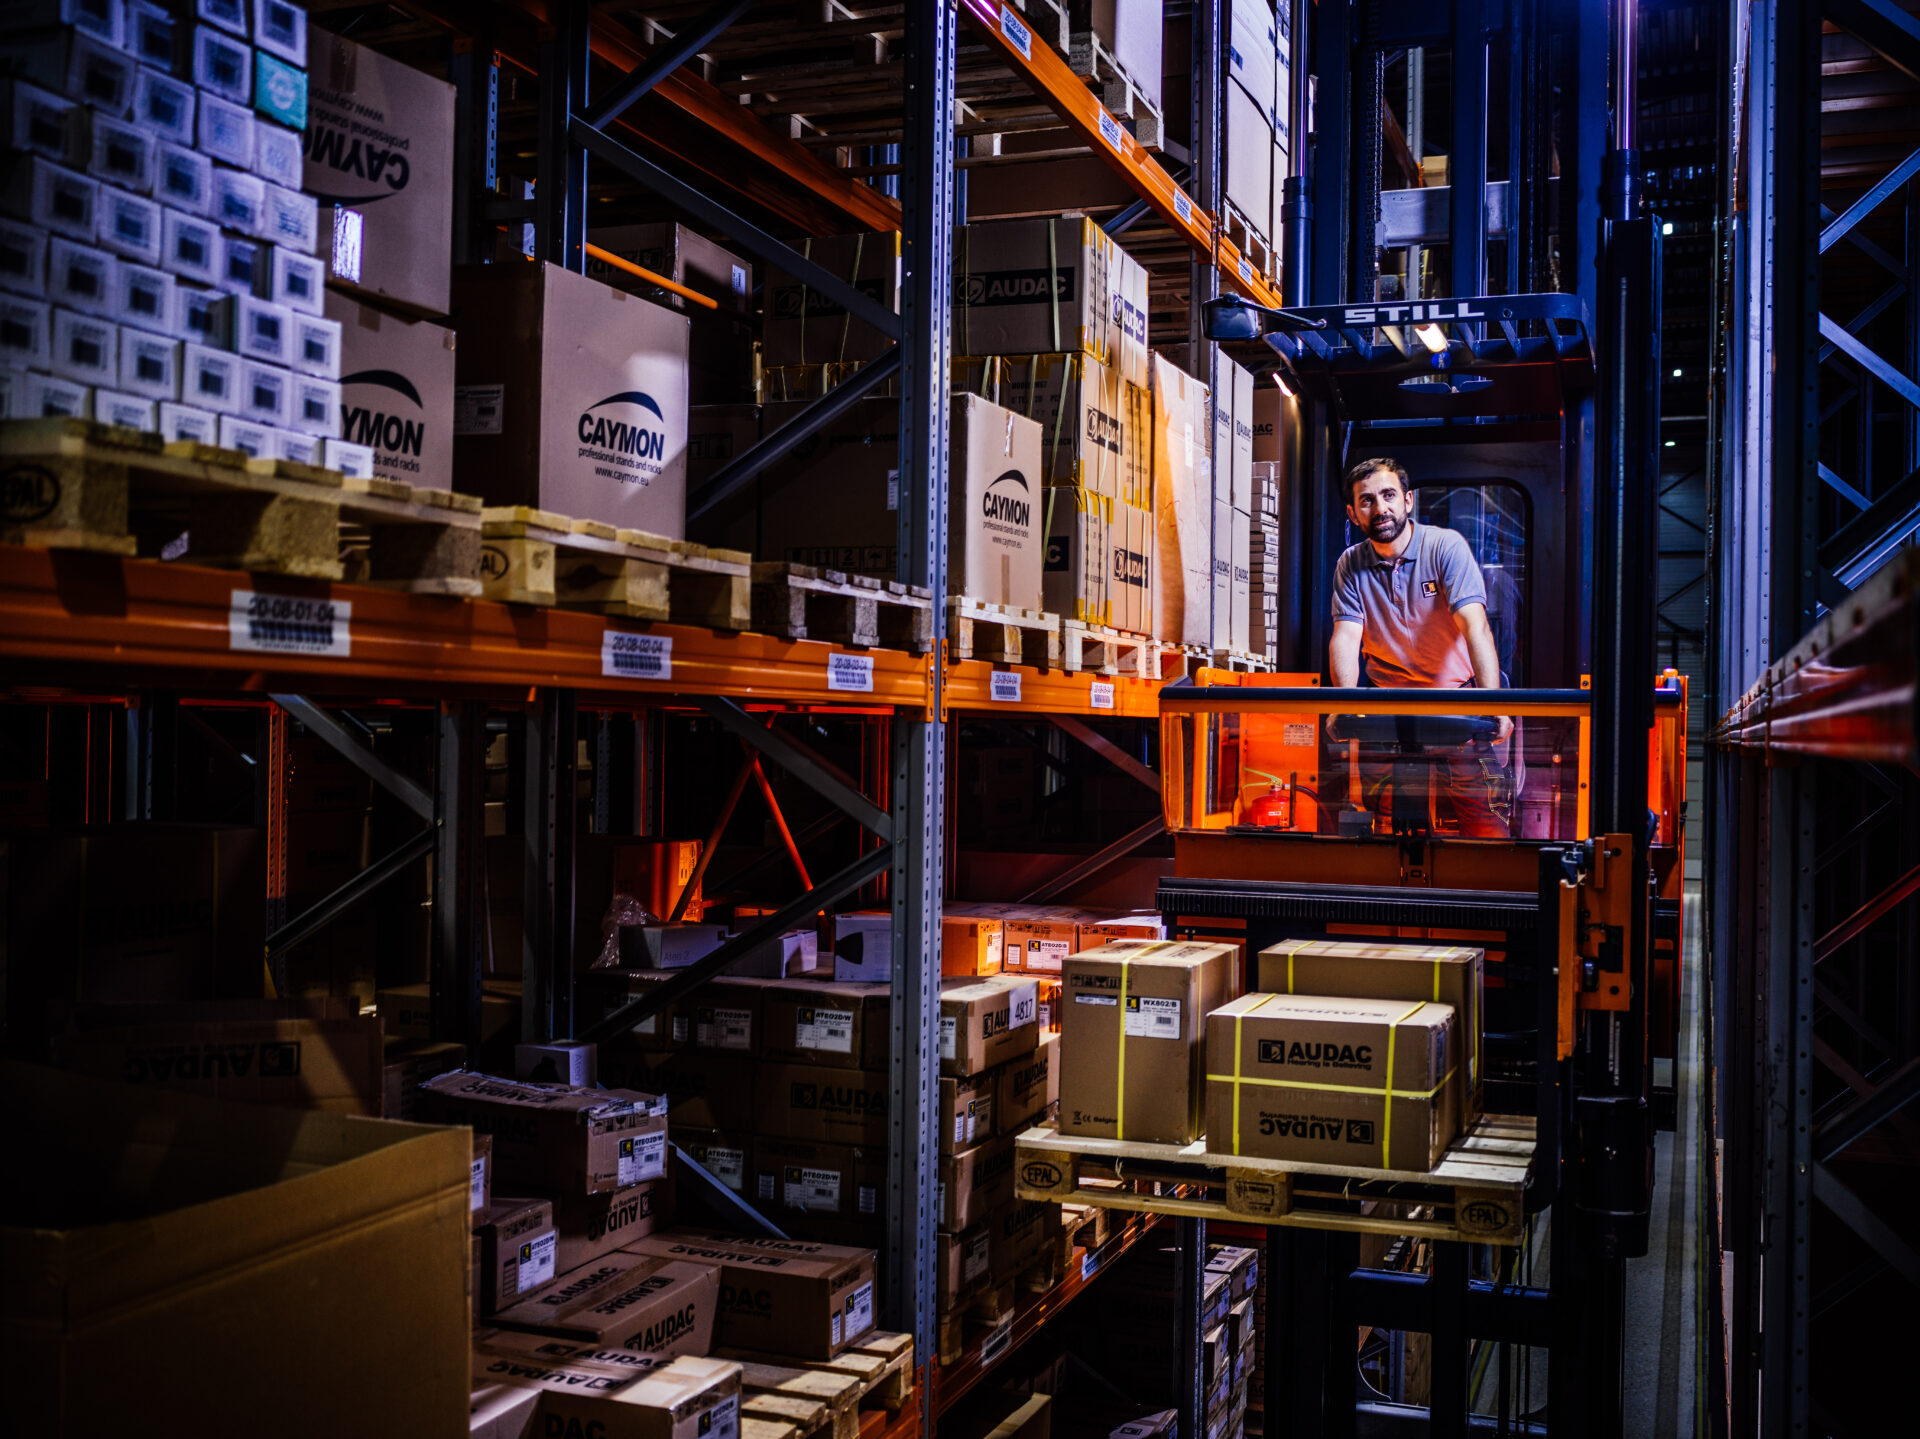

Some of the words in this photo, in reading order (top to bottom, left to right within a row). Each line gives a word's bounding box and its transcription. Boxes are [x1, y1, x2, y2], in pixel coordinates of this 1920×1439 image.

[989, 275, 1067, 298] AUDAC
[1344, 302, 1485, 324] STILL
[578, 413, 664, 461] CAYMON
[578, 447, 615, 464] professional
[615, 456, 635, 469] stands
[635, 461, 647, 471] and
[647, 464, 662, 475] racks
[595, 466, 649, 487] www.caymon.eu
[983, 491, 1030, 527] CAYMON
[992, 537, 1022, 549] www.caymon.eu
[248, 598, 335, 622] 20-08-01-04
[1015, 998, 1034, 1021] 4817
[1143, 999, 1177, 1008] WX802/B
[1288, 1042, 1372, 1063] AUDAC
[1287, 1059, 1321, 1067] Hearing
[1332, 1061, 1372, 1070] Believing
[1259, 1111, 1299, 1121] Believing
[1310, 1115, 1344, 1125] Hearing
[1259, 1118, 1344, 1141] AUDAC
[1028, 1167, 1055, 1183] EPAL
[588, 1207, 638, 1241] AUDAC
[1469, 1209, 1502, 1226] EPAL
[669, 1245, 752, 1262] AUDAC
[560, 1267, 617, 1300] AUDAC
[642, 1303, 695, 1351] AUDAC
[573, 1349, 675, 1368] AUDAC
[487, 1361, 587, 1385] AUDAC
